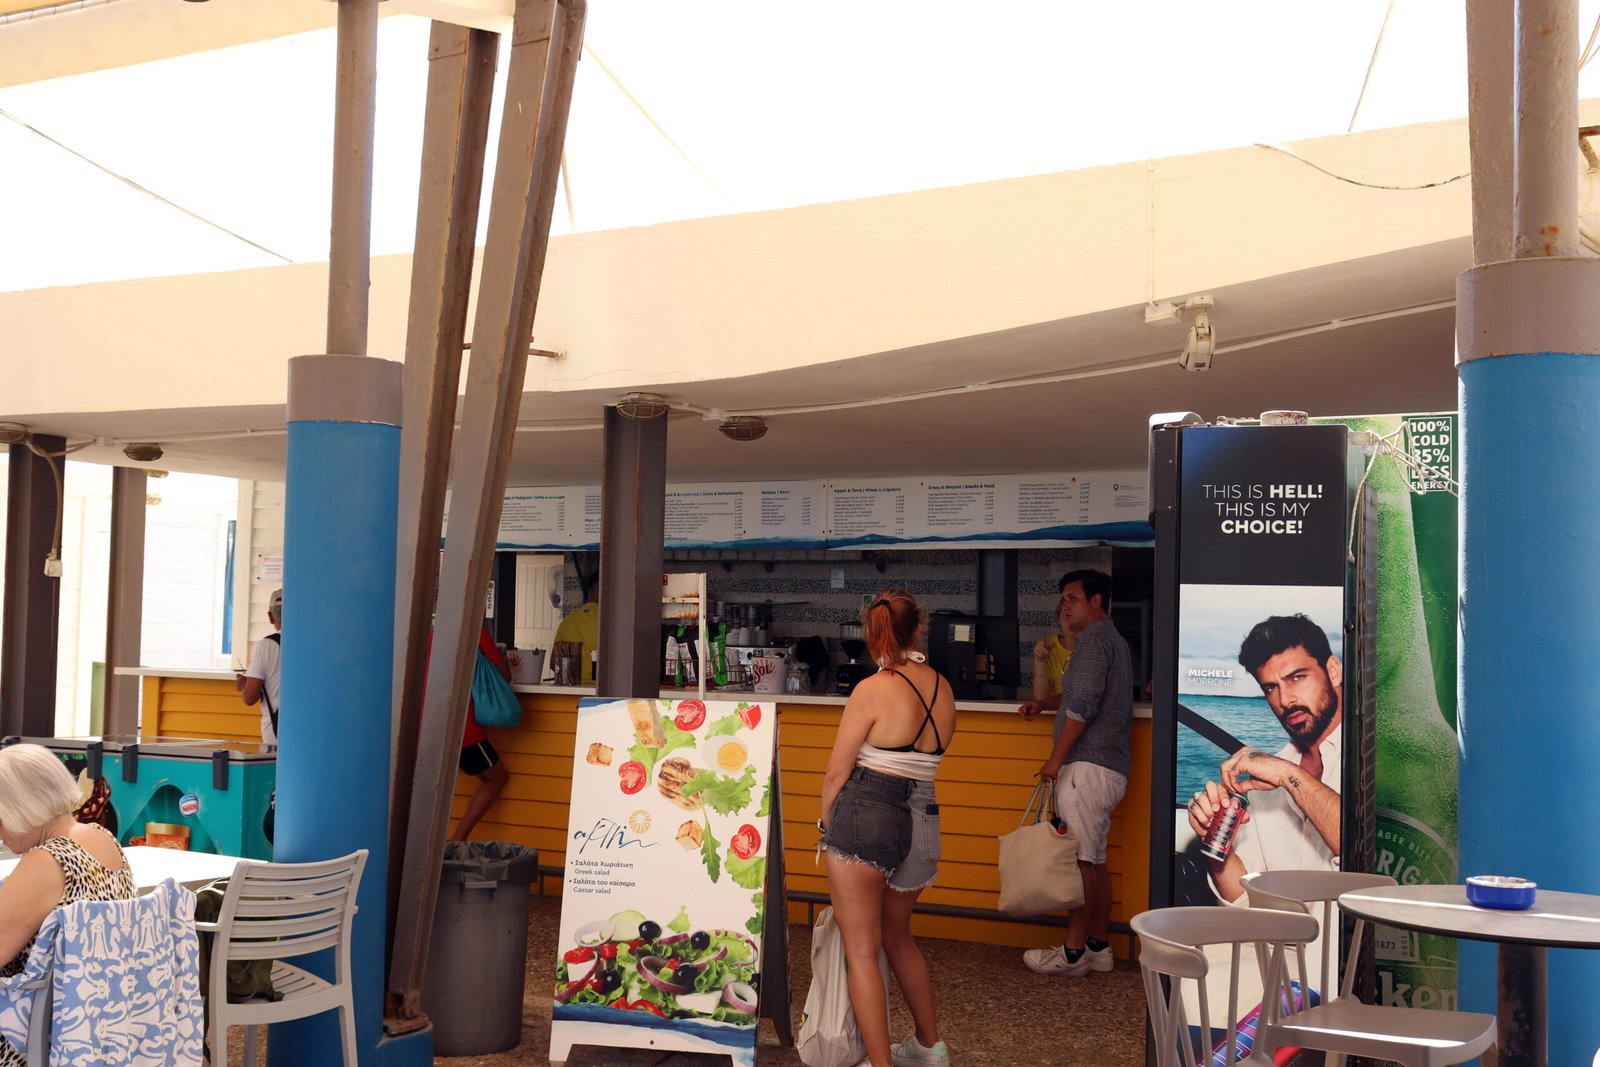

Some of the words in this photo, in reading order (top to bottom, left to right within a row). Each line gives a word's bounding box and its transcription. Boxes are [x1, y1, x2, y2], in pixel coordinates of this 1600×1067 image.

[1411, 420, 1450, 432] 100%
[1412, 434, 1450, 446] COLD
[1202, 484, 1241, 498] THIS
[1248, 484, 1263, 498] IS
[1270, 484, 1323, 498] HELL!
[1215, 502, 1254, 516] THIS
[1261, 502, 1275, 516] IS
[1282, 502, 1310, 516] MY
[1221, 520, 1303, 534] CHOICE!
[1188, 669, 1233, 677] MICHELE
[1188, 678, 1232, 686] MORRONE
[1378, 830, 1405, 845] AGER
[1409, 843, 1431, 860] BEER
[1376, 941, 1396, 950] 1873
[1374, 972, 1457, 1011] ken
